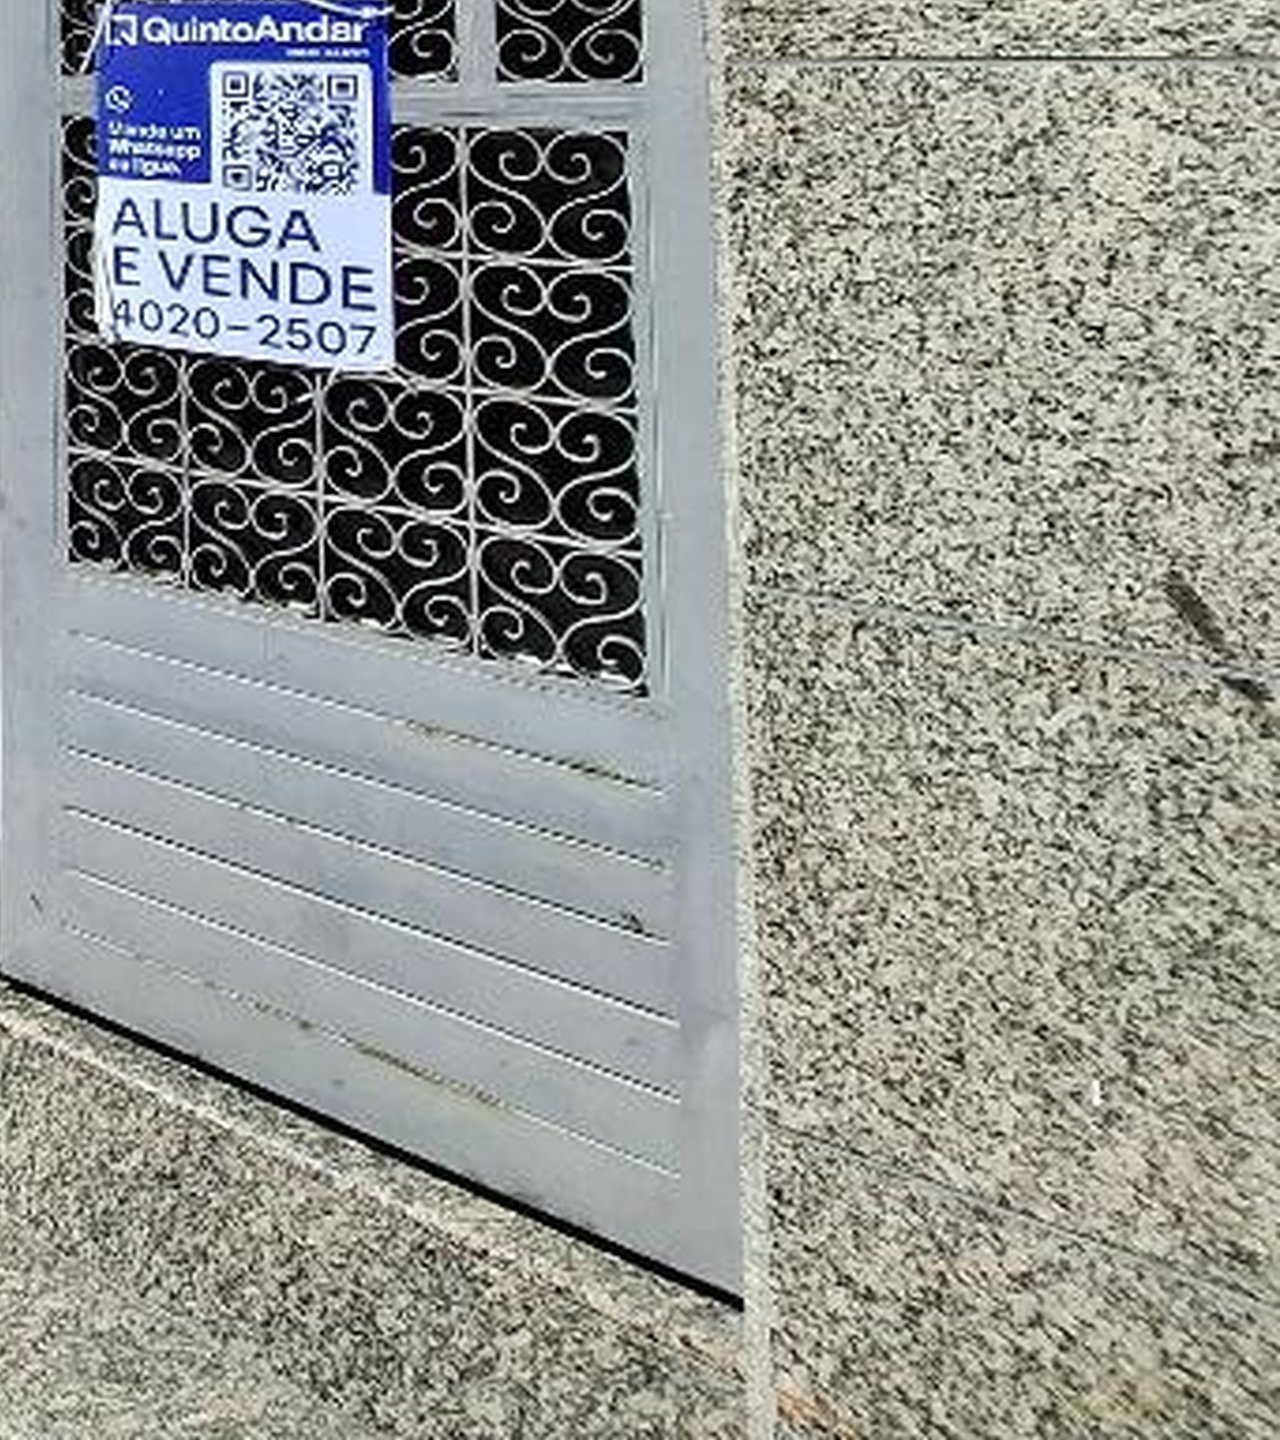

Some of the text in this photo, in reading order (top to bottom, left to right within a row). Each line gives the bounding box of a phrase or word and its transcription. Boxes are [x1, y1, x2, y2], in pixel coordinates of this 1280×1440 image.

[142, 15, 368, 46] QuintoAndar
[112, 197, 321, 252] ALUGA
[113, 245, 377, 312] E VENDE
[113, 298, 377, 355] 4020-2507
